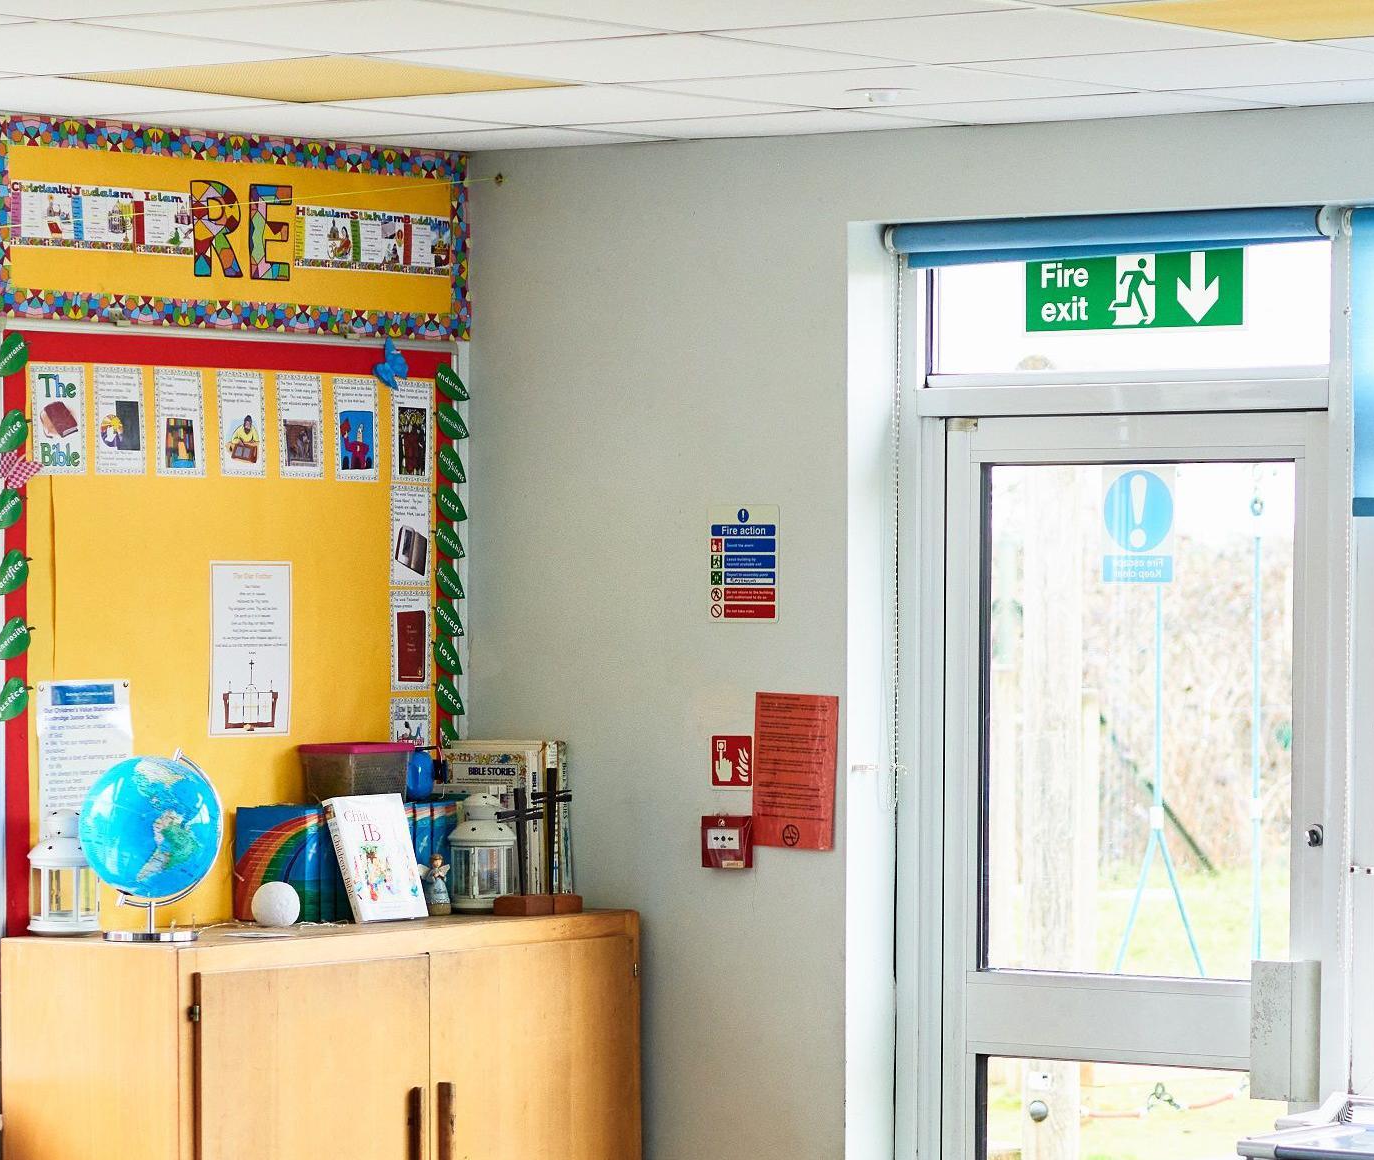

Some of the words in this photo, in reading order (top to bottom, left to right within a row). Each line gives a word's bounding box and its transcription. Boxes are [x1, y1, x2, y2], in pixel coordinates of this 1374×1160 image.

[11, 181, 73, 198] Christianity
[72, 186, 133, 199] Judaism
[144, 191, 183, 203] Islam
[296, 206, 350, 219] Hinduism
[350, 211, 403, 222] Sikhism
[403, 215, 450, 228] Buddhism
[190, 179, 293, 281] RE
[1041, 263, 1089, 289] Fire
[1041, 297, 1089, 322] exit
[38, 374, 77, 398] The
[437, 372, 469, 398] endurance
[438, 410, 467, 438] responsibility
[40, 443, 80, 467] Bible
[439, 451, 465, 482] truthfulness
[441, 494, 459, 513] trust
[437, 528, 464, 557] friendship
[722, 526, 738, 535] Fire
[739, 526, 766, 535] action
[437, 567, 464, 598] forgiveness
[436, 606, 463, 635] courage
[439, 642, 456, 667] love
[438, 683, 462, 710] peace
[468, 767, 486, 776] BIBLE
[487, 767, 516, 776] STORIES
